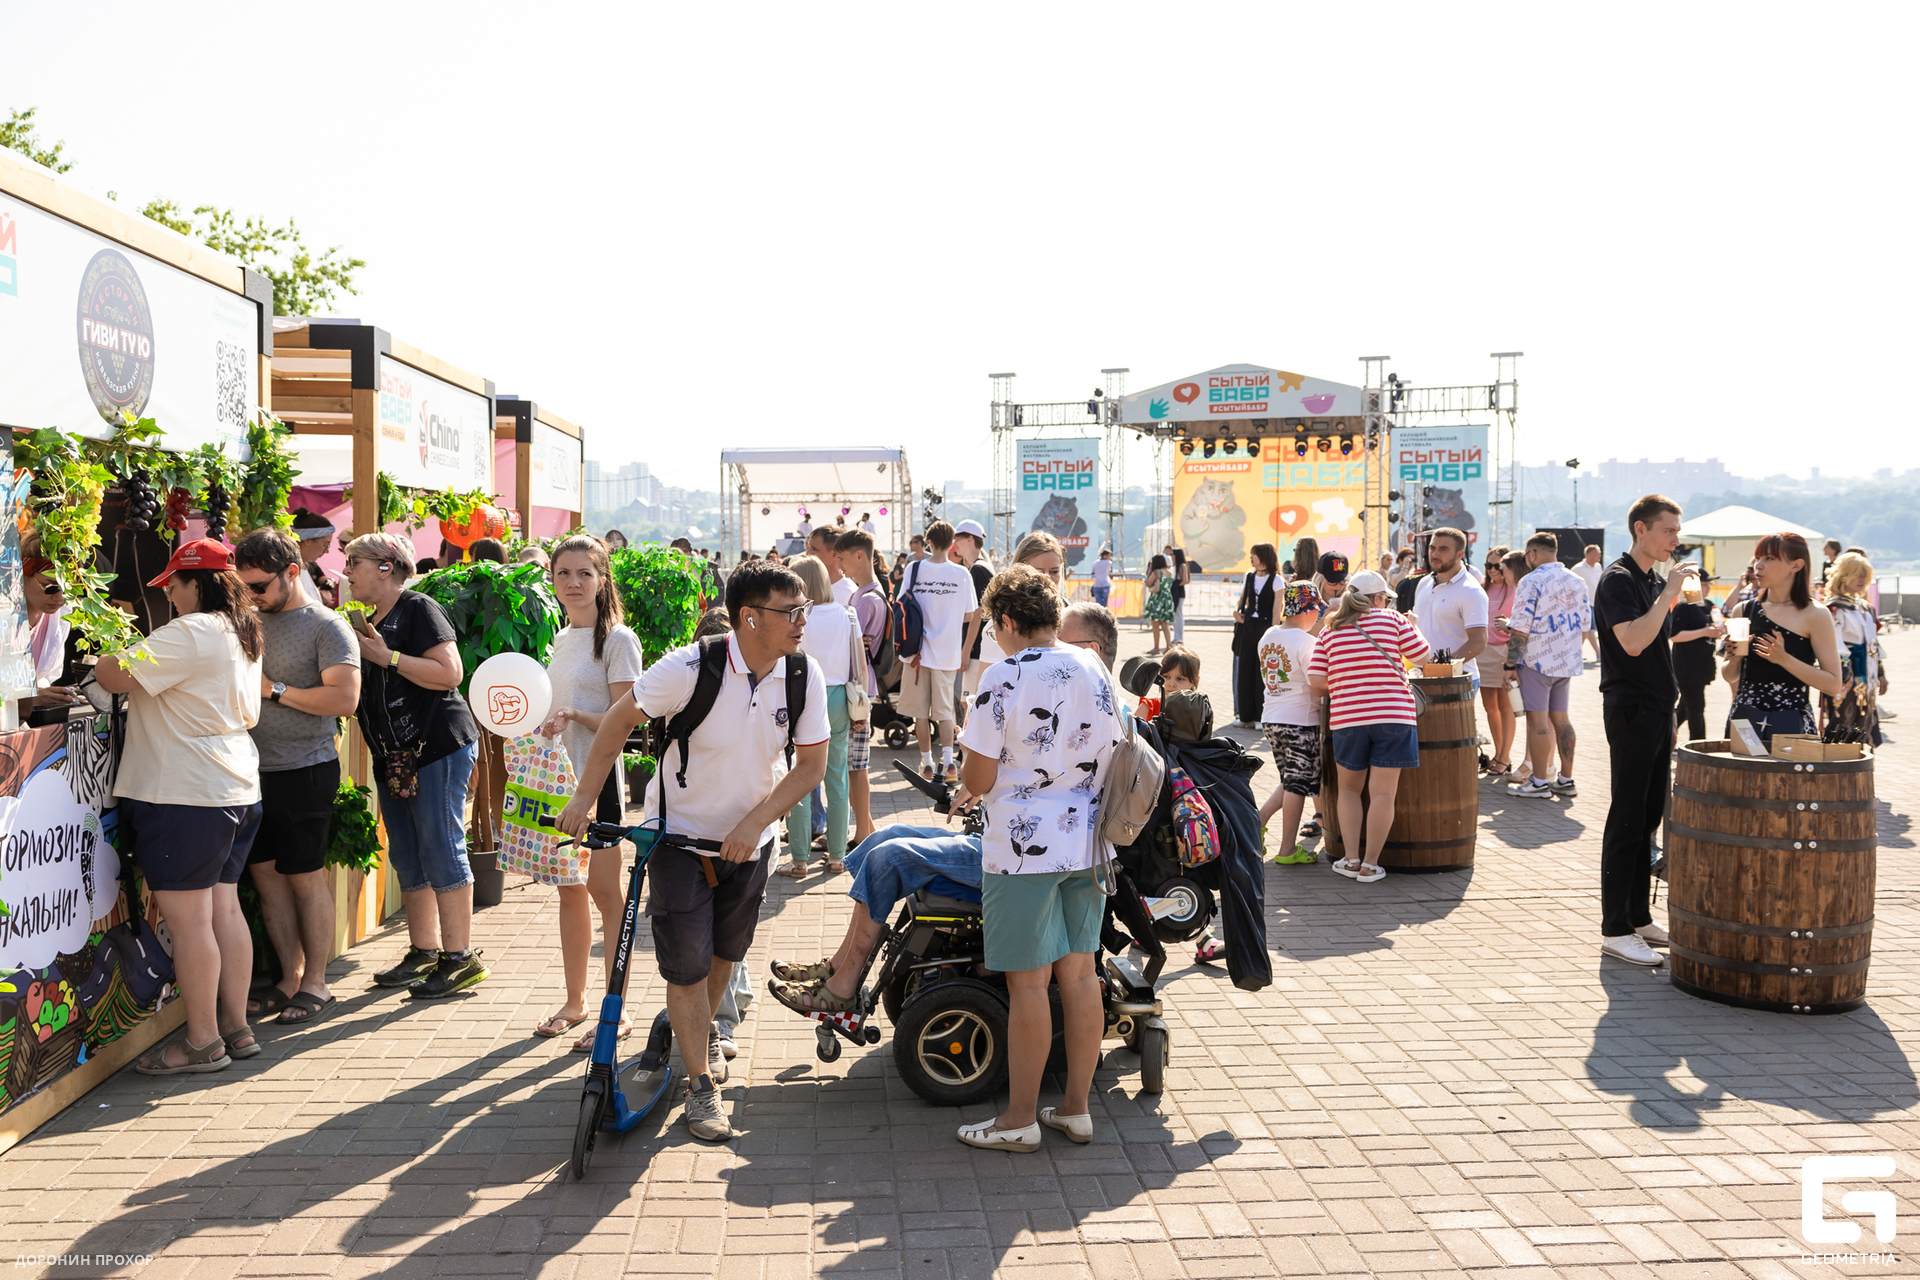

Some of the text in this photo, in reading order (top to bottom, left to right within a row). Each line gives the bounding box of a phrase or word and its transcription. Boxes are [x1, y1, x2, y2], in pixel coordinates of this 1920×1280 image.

[95, 284, 138, 327] РЕСТОРАН
[82, 318, 119, 350] ГИВИ
[380, 371, 412, 401] СЫТЫЙ
[1209, 372, 1269, 388] СЫТЫЙ
[1209, 387, 1269, 402] БАБР
[381, 393, 412, 426] БАБР
[429, 413, 460, 453] Chino
[1023, 456, 1093, 473] СЫТЫЙ
[1400, 445, 1482, 464] СЫТЫЙ
[1187, 462, 1249, 472] #СЫТЫЙБАБР
[1263, 463, 1366, 488] БАБР
[1400, 463, 1482, 482] БАБР
[1023, 473, 1093, 490] БАБР
[616, 899, 635, 972] REACTION
